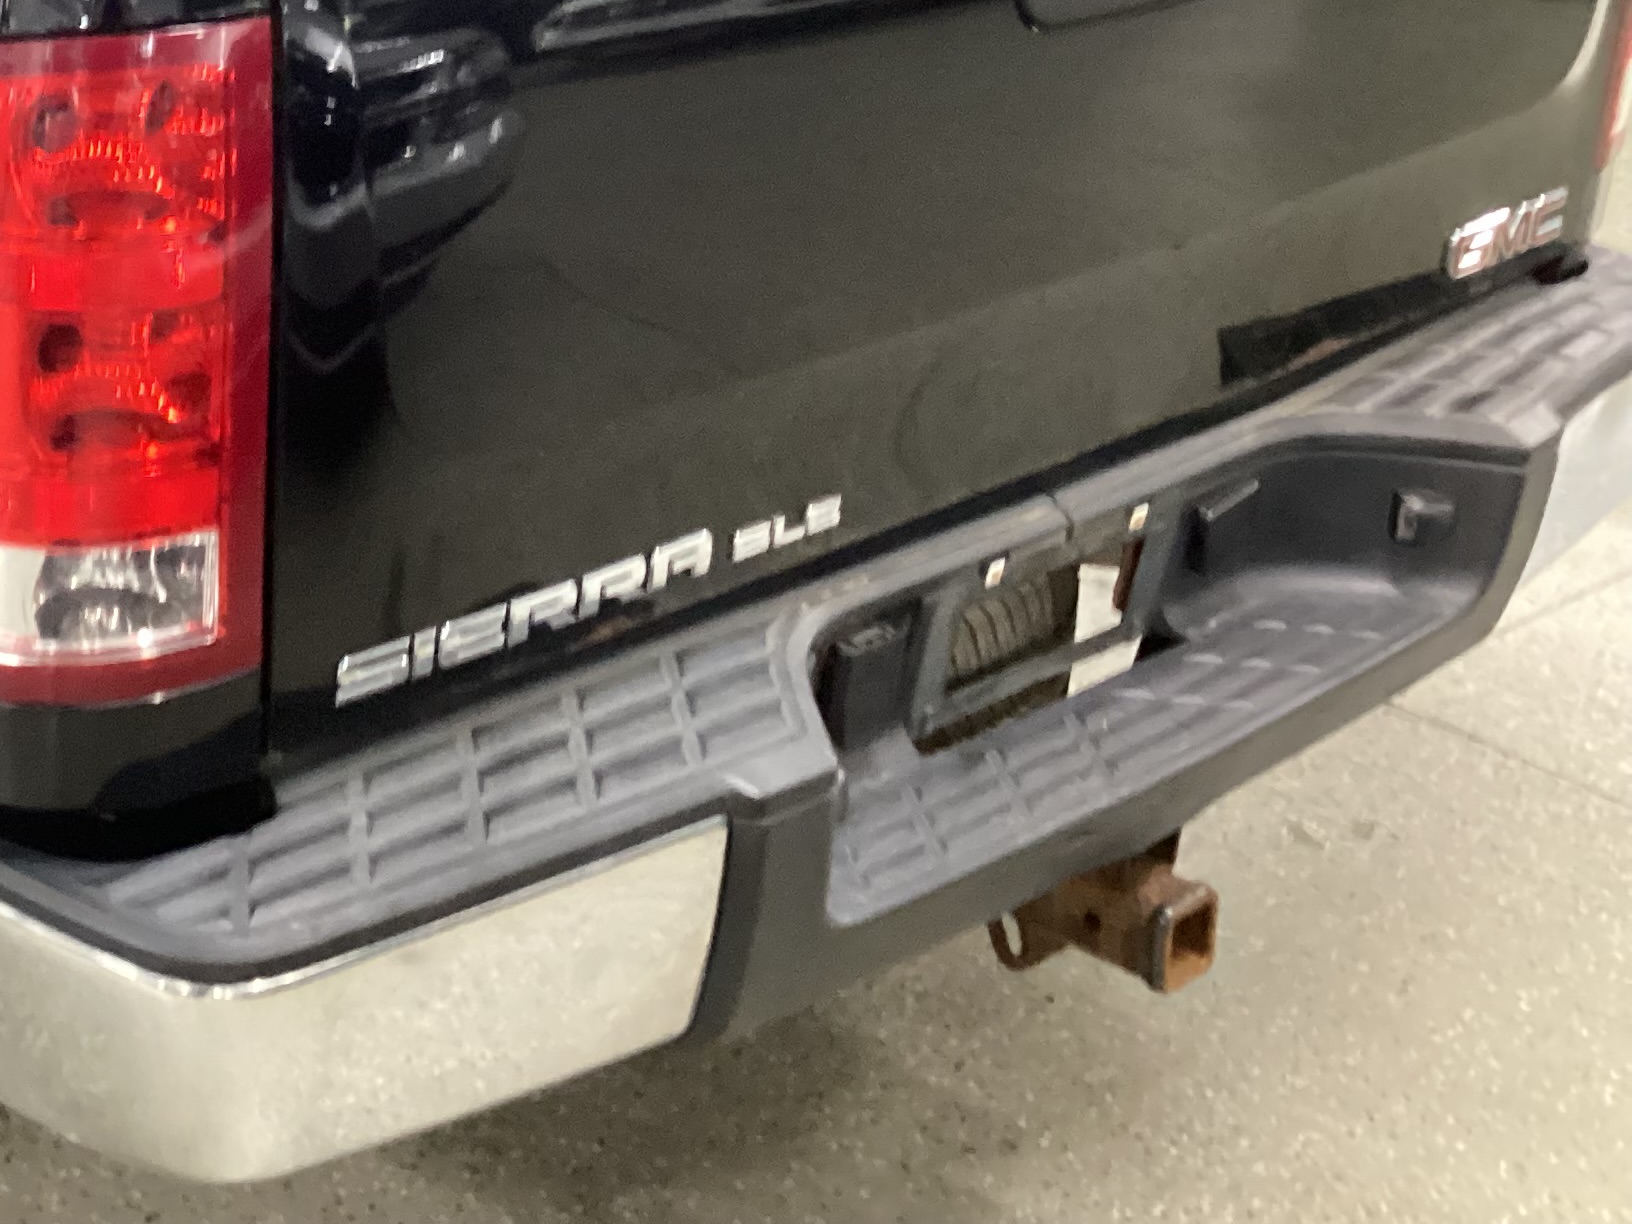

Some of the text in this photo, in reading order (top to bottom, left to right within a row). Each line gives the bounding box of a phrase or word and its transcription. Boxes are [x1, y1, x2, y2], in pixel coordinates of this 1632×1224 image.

[1448, 187, 1568, 280] GMC
[335, 493, 843, 709] SIERRA SLE
